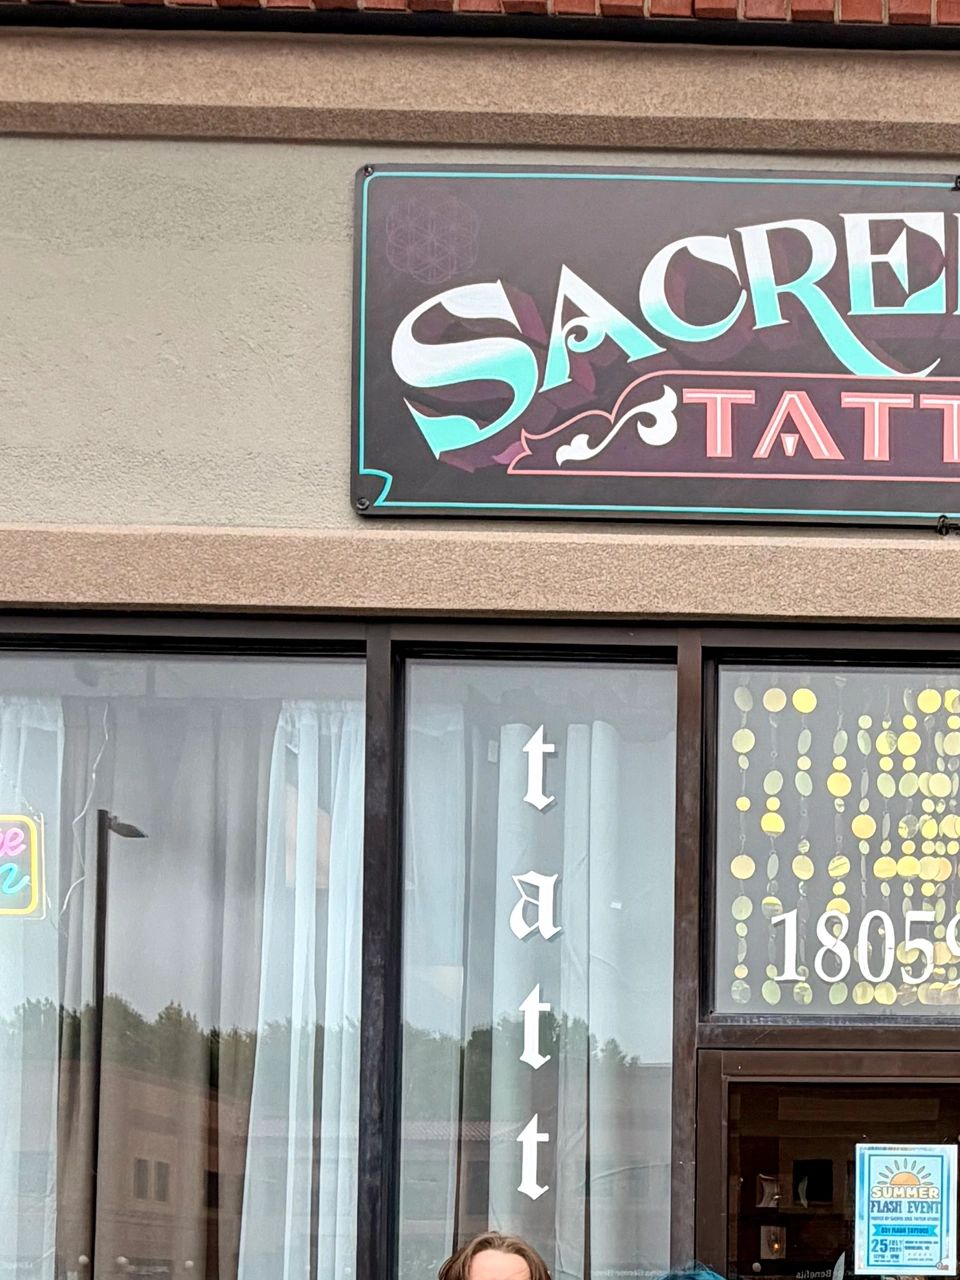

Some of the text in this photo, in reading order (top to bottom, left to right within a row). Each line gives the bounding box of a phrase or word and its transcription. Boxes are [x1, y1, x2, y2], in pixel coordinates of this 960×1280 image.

[871, 1186, 940, 1200] SUMMER
[870, 1200, 941, 1214] FLASH EVENT
[871, 1239, 888, 1253] 25
